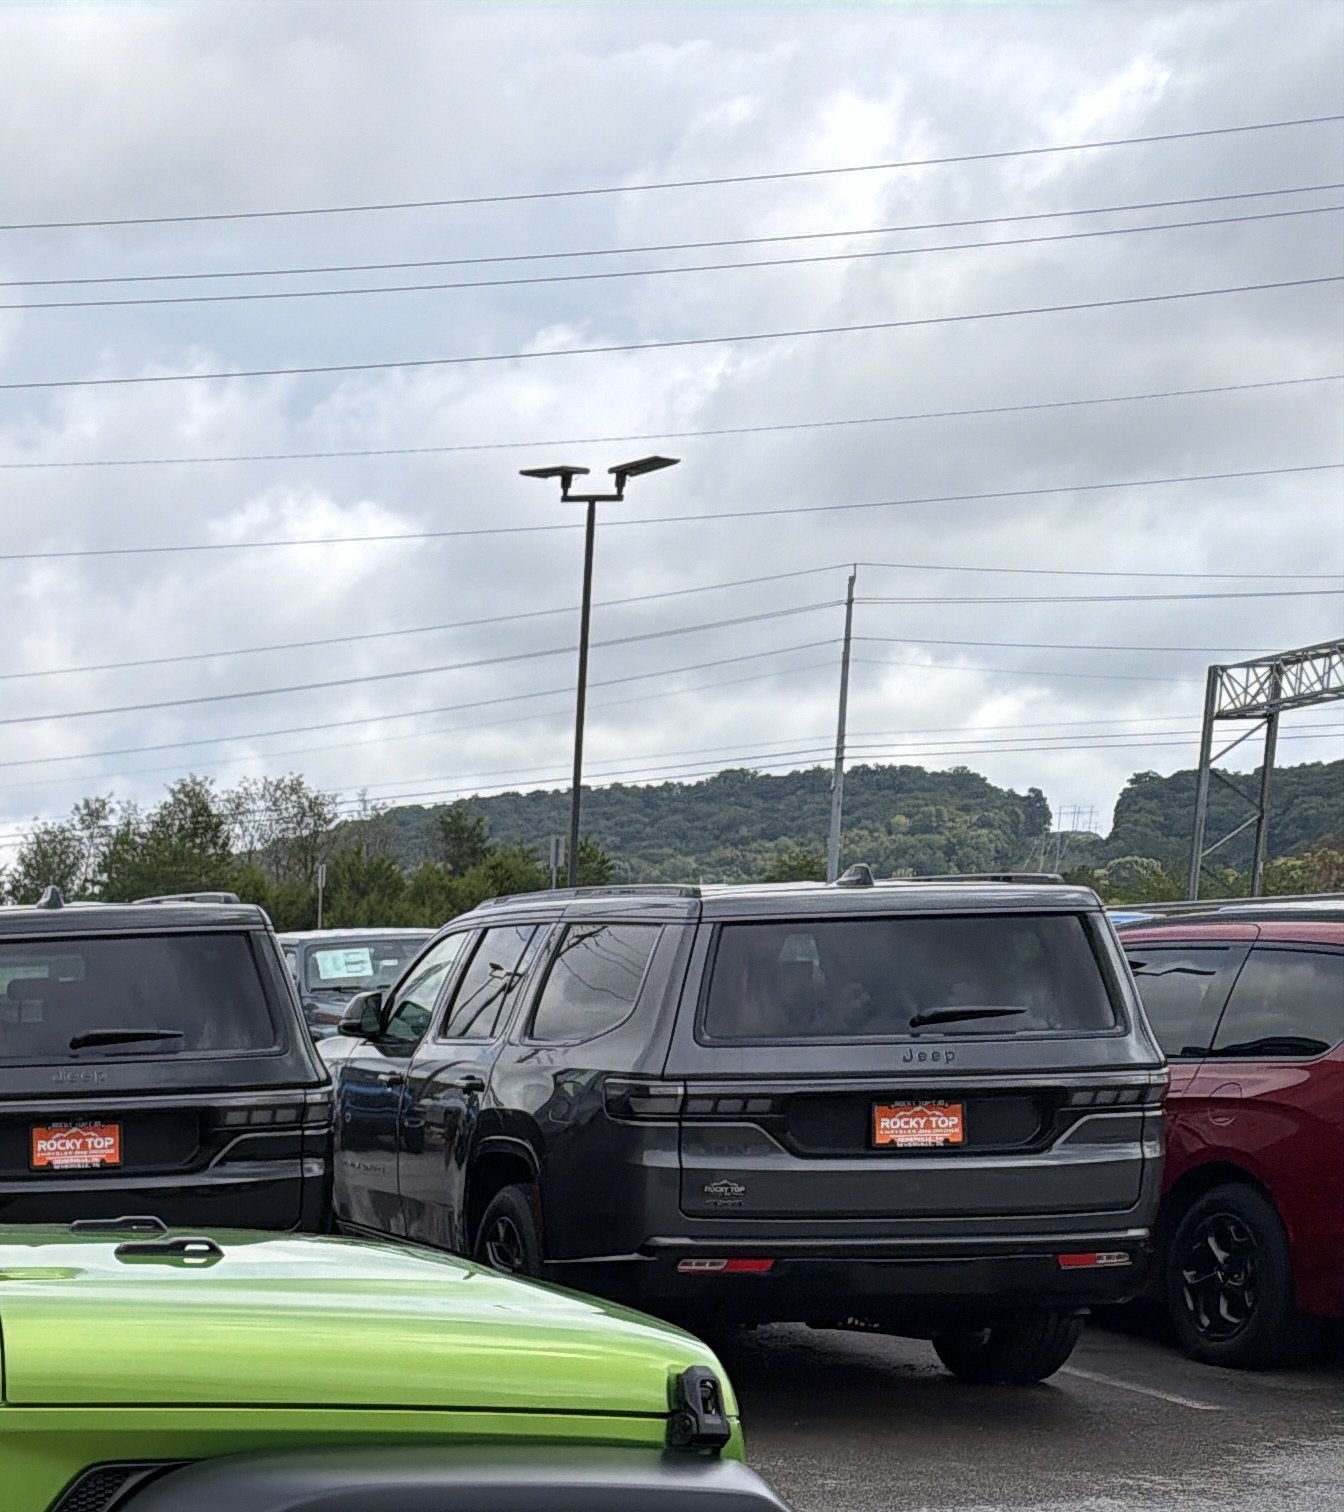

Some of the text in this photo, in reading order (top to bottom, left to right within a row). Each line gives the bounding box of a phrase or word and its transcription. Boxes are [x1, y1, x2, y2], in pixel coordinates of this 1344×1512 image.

[902, 1047, 955, 1065] Jeep
[52, 1069, 108, 1086] Jeep
[880, 1117, 958, 1128] ROCKY TOP
[37, 1137, 114, 1151] ROCKY TOP
